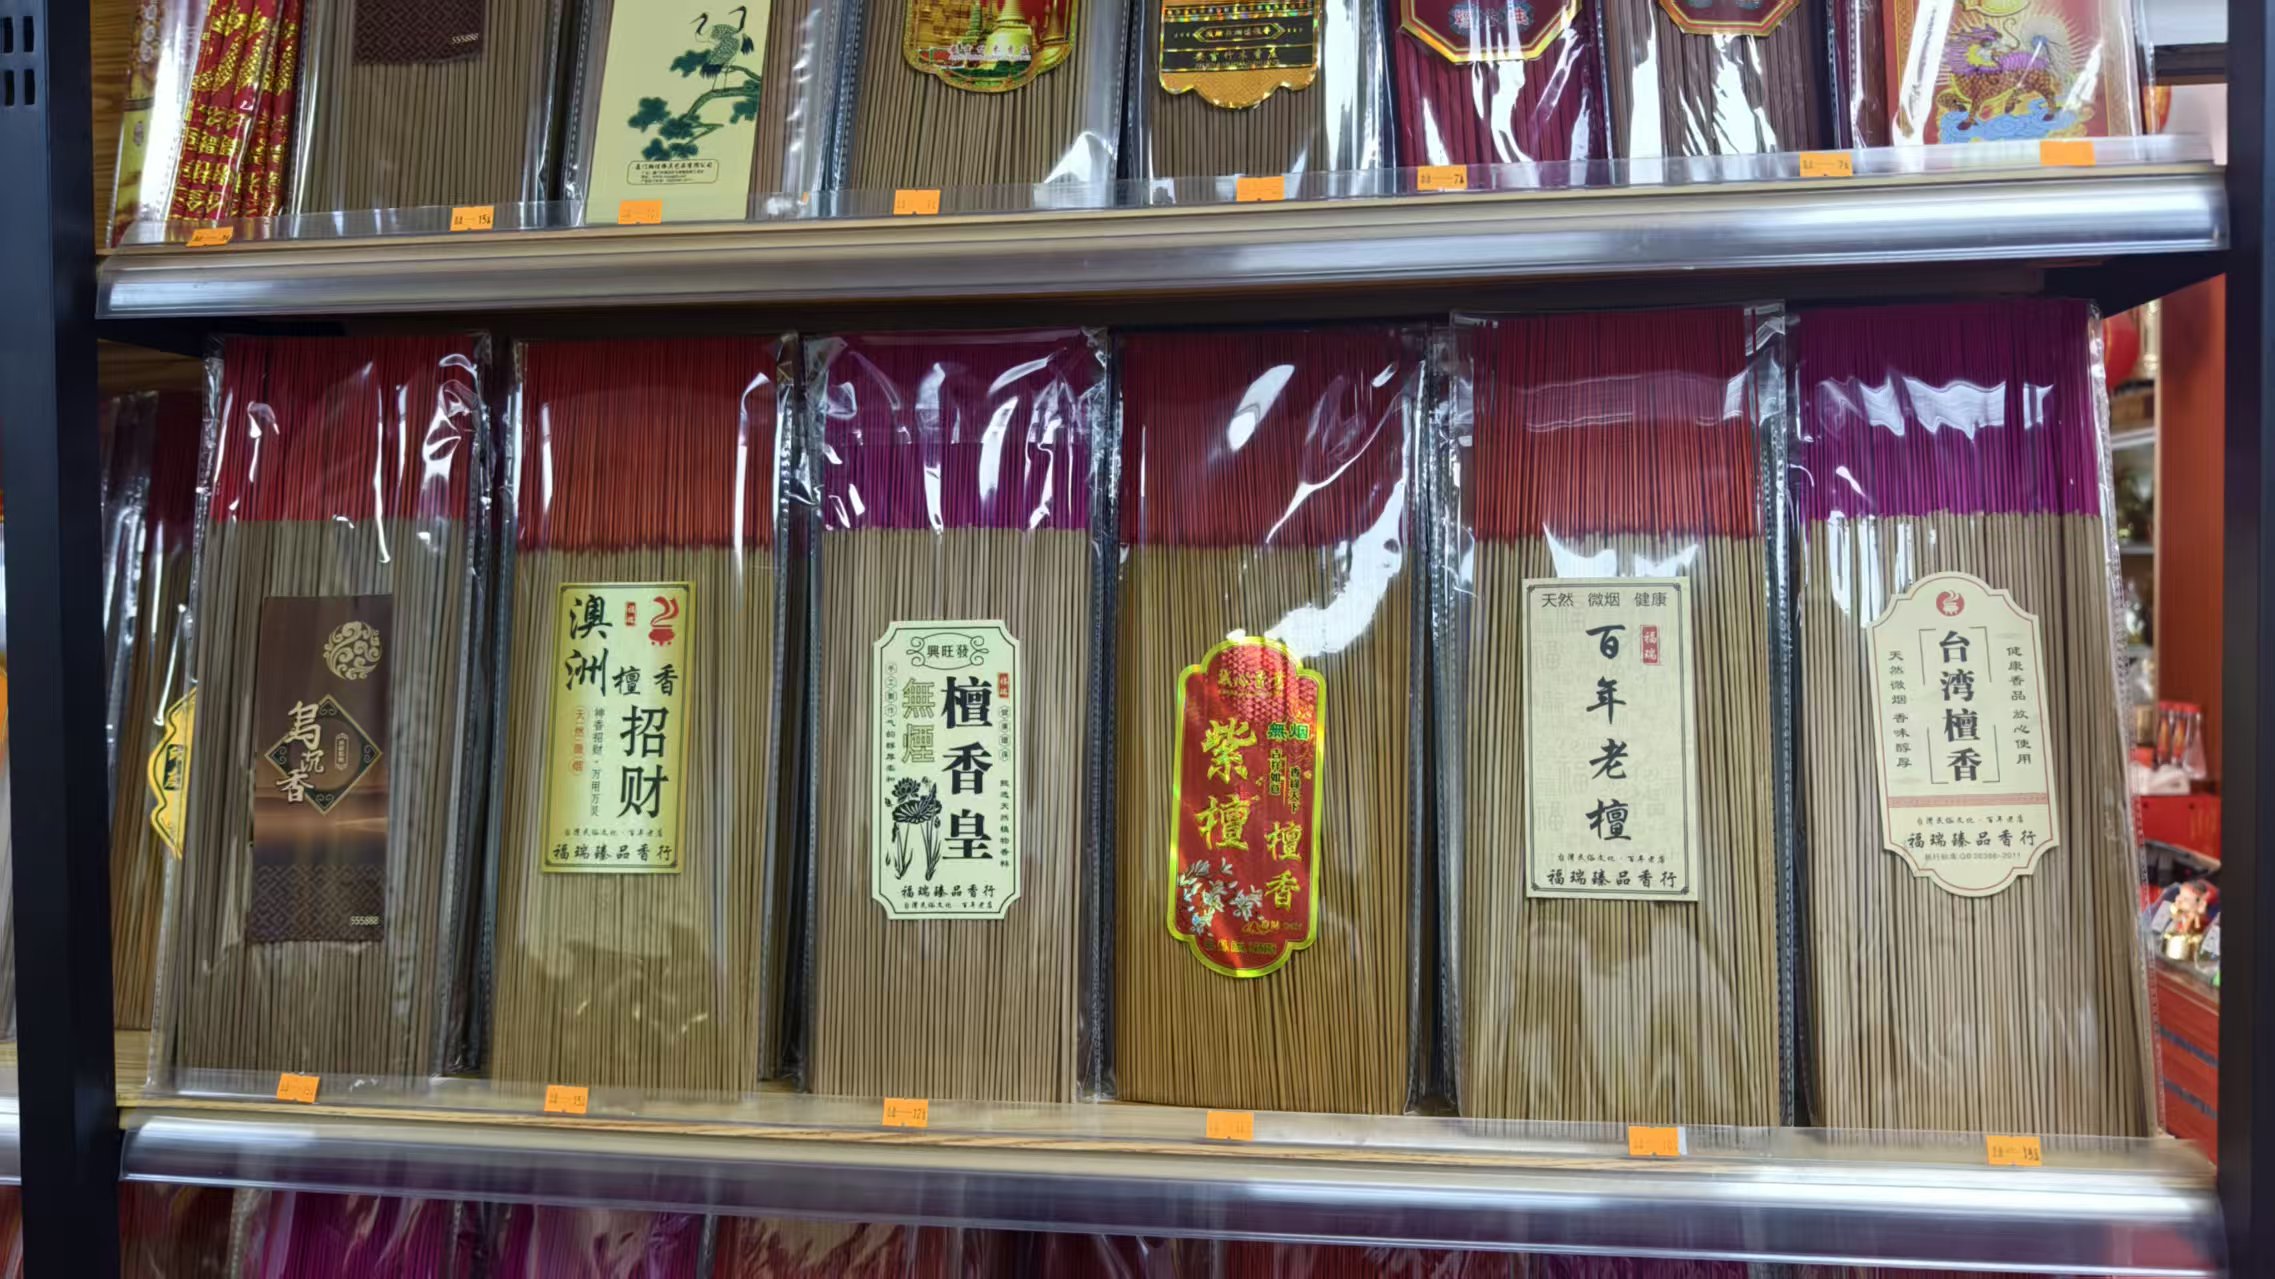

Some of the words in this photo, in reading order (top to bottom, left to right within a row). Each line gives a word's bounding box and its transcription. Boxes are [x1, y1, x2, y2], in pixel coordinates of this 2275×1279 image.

[1541, 593, 1575, 608] 天然
[1588, 592, 1621, 607] 微烟
[1634, 592, 1668, 607] 健康
[565, 593, 612, 697] 澳洲
[927, 644, 970, 659] 興旺發
[612, 663, 679, 696] 檀香
[1888, 650, 1908, 705] 天然微烟
[2006, 646, 2027, 701] 健康香品
[1585, 624, 1632, 841] 百年老檀
[1939, 630, 1983, 782] 台湾檀香
[619, 705, 669, 818] 招财
[1892, 713, 1913, 769] 香味醇厚
[2013, 708, 2033, 765] 放心使用
[941, 676, 993, 860] 檀香皇
[1195, 717, 1258, 851] 紫檀
[553, 844, 673, 862] 福瑞臻品香行
[1264, 820, 1303, 911] 檀香
[1906, 830, 2038, 850] 福瑞臻品香行
[901, 885, 996, 898] 福瑞臻品香行
[1546, 869, 1678, 888] 福瑞臻品香行
